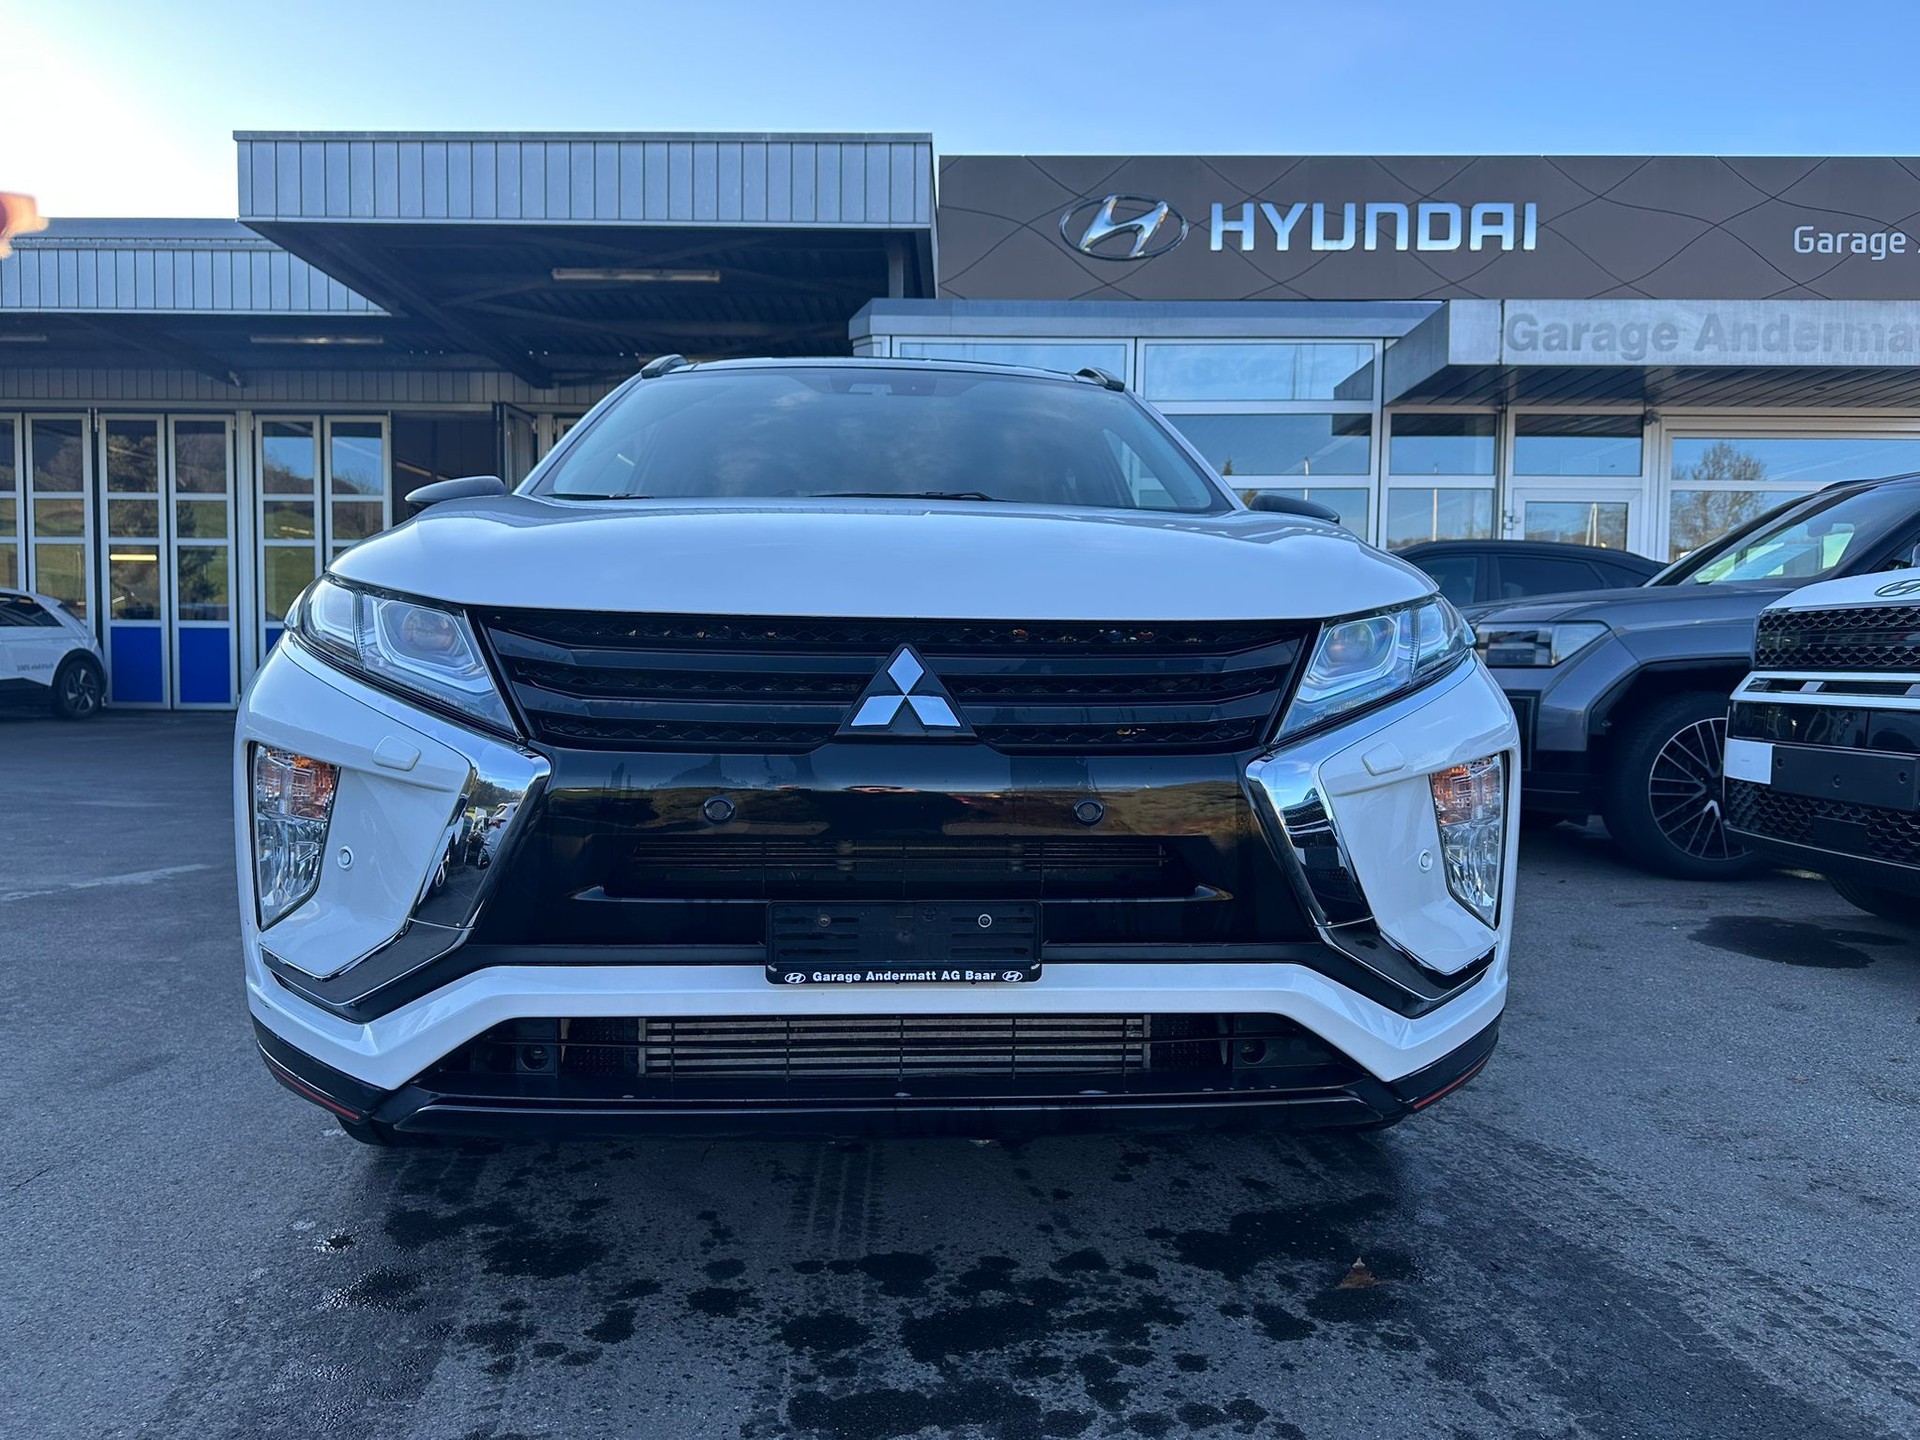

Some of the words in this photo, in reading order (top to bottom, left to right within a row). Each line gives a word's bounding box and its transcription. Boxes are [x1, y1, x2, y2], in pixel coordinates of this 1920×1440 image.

[1209, 202, 1537, 252] HYUNDAI
[1794, 225, 1907, 261] Garage
[1505, 314, 1680, 361] Garage
[1693, 314, 1920, 354] Anderma
[812, 971, 861, 983] Garage
[865, 970, 937, 981] Andermatt
[941, 970, 960, 981] AG
[965, 970, 997, 981] Baar
